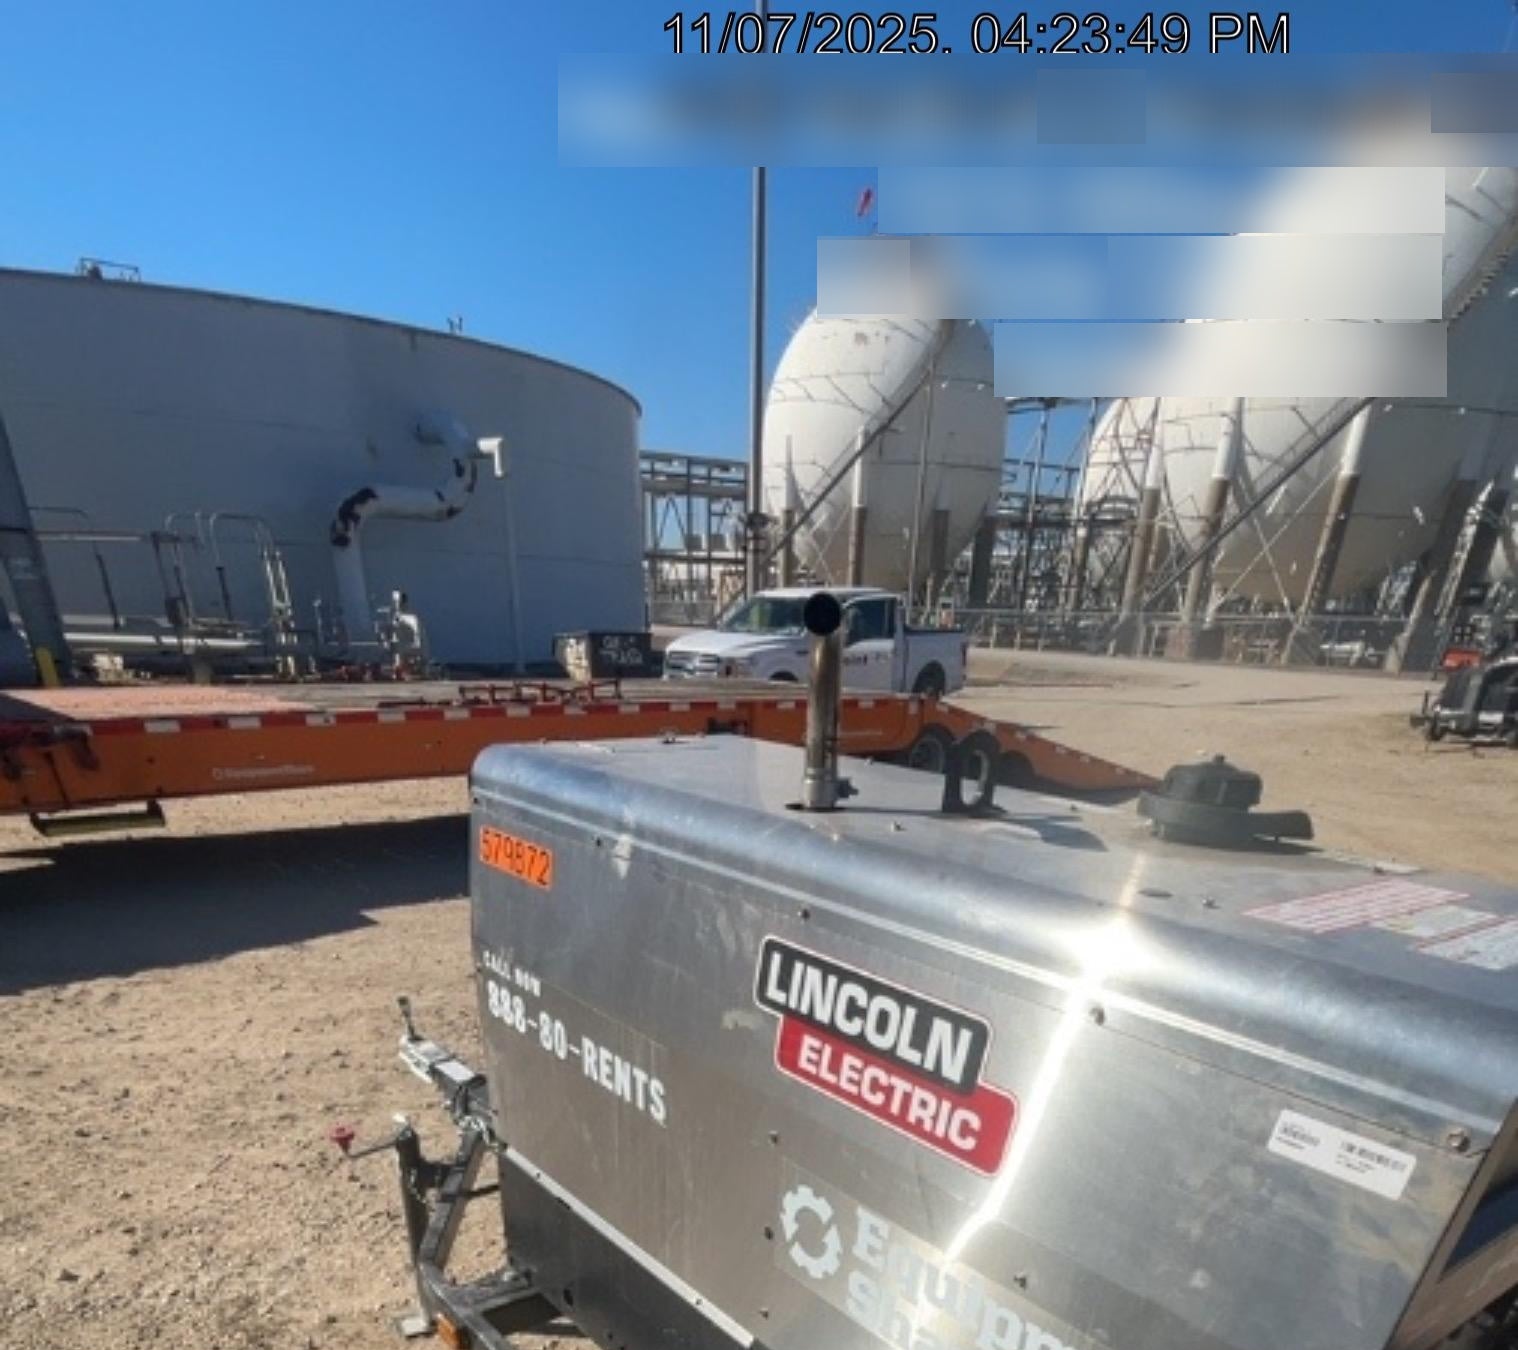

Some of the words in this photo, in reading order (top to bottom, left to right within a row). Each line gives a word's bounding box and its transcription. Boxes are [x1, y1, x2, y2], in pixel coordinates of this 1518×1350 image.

[487, 980, 667, 1127] 888-80-RENTS
[765, 952, 973, 1084] LINCOLN
[797, 1034, 982, 1152] ELECTRIC
